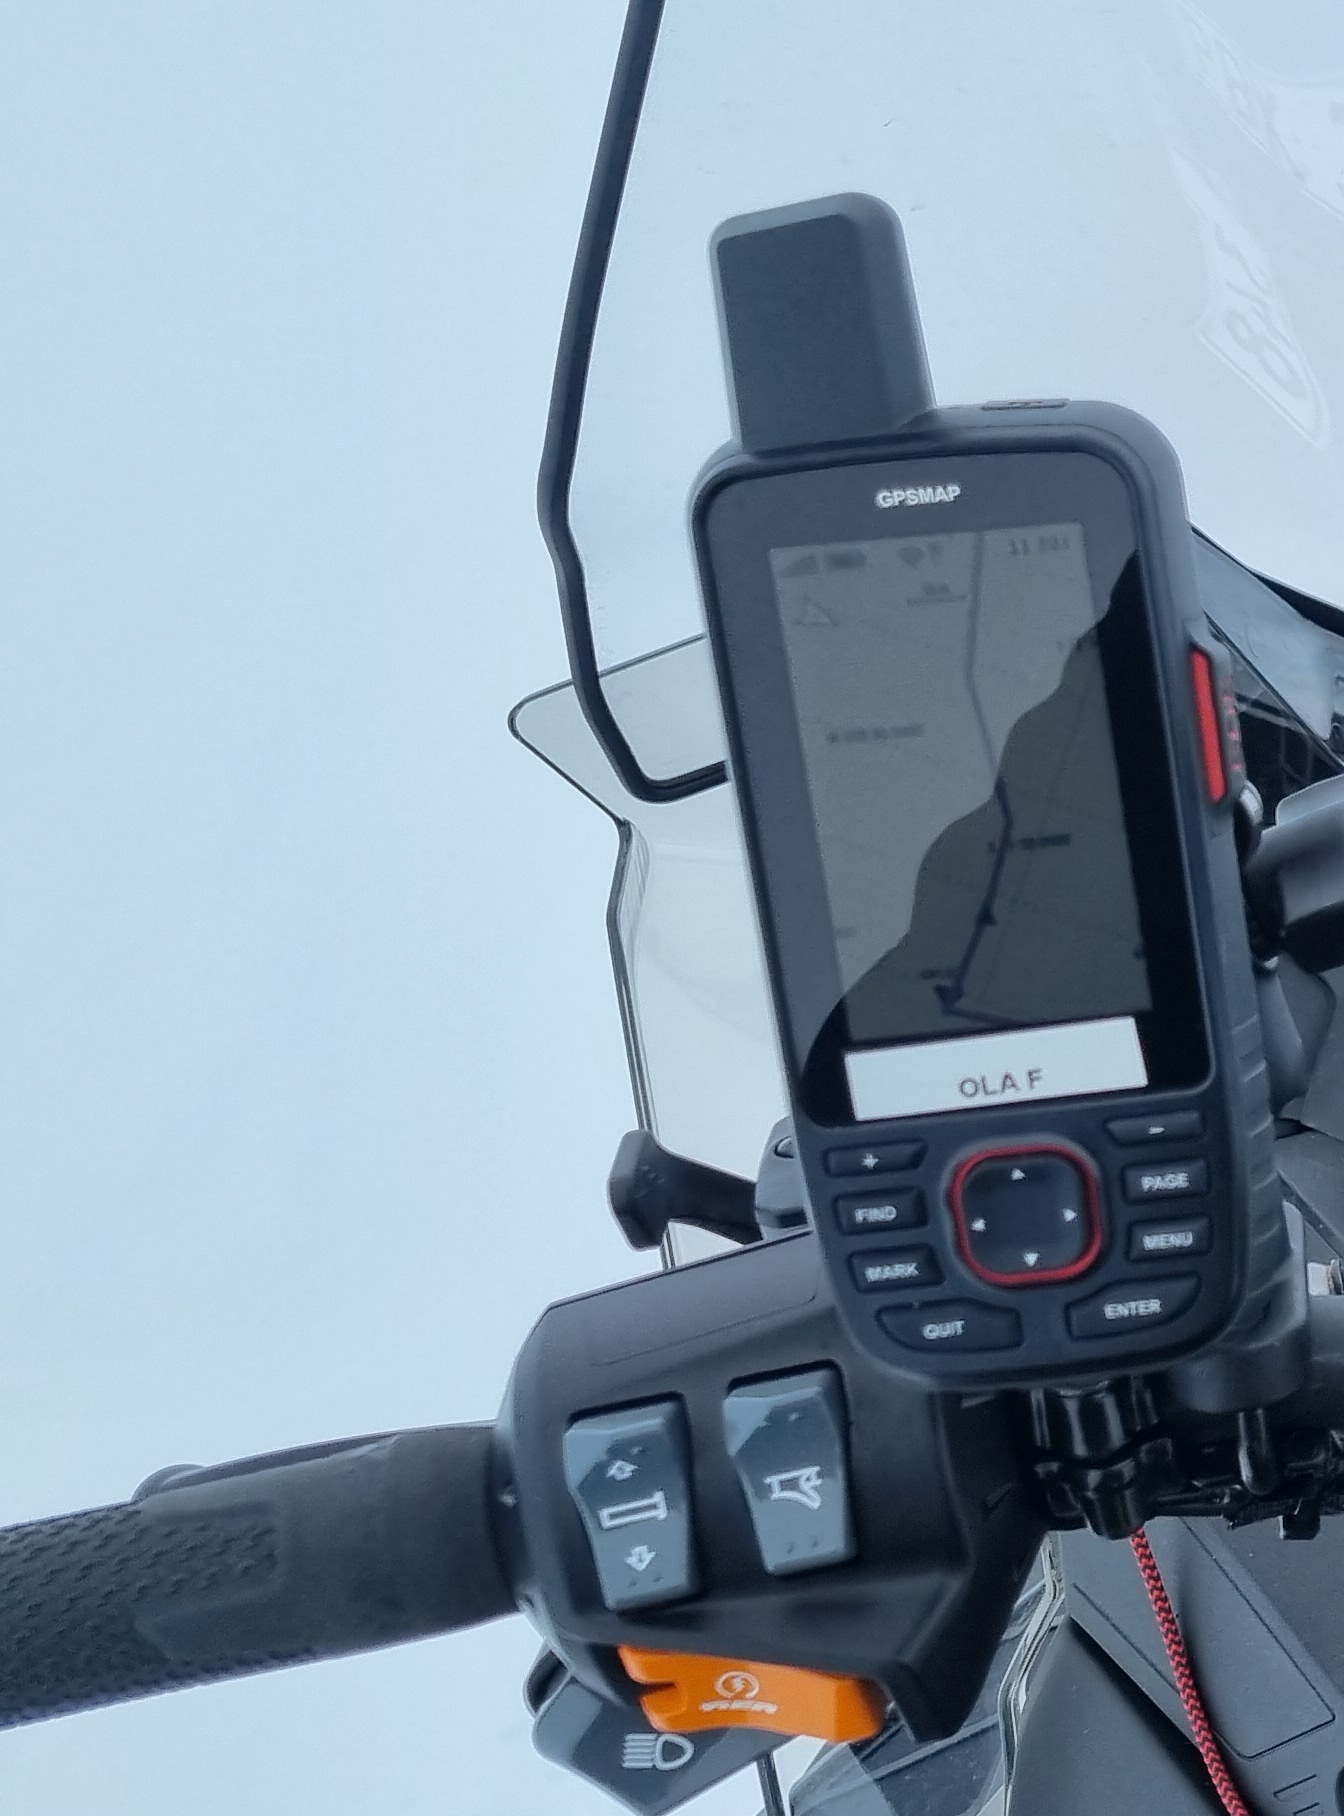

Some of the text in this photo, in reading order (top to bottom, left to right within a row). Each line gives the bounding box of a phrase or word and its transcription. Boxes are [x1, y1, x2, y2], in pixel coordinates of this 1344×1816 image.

[876, 484, 961, 509] GPSMAP
[1141, 1171, 1189, 1191] PAGE
[854, 1206, 897, 1223] FIND
[1143, 1231, 1193, 1250] MENU
[865, 1262, 919, 1281] MARK
[1104, 1299, 1163, 1319] ENTER
[922, 1319, 966, 1339] QUIT
